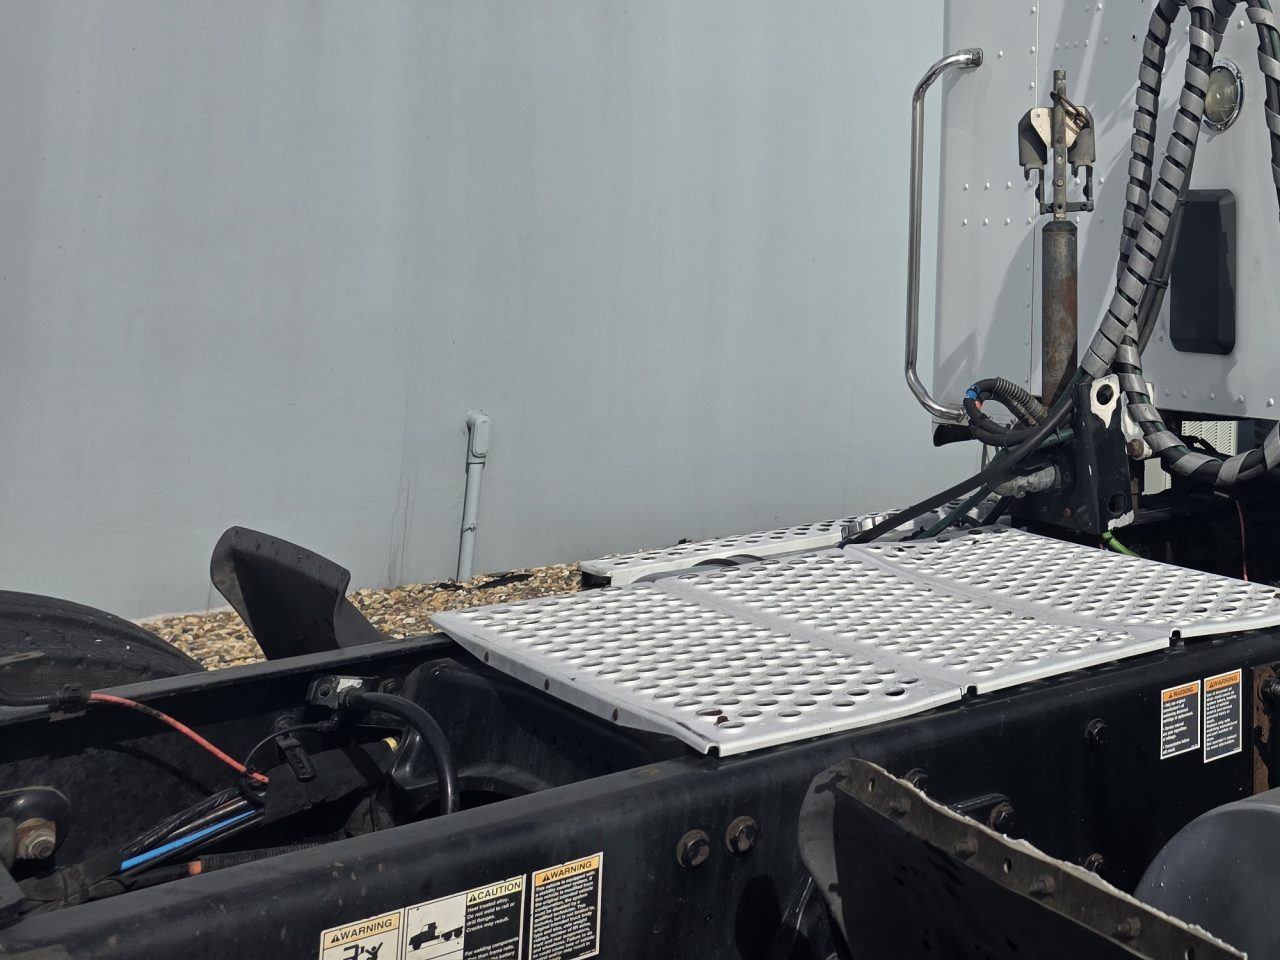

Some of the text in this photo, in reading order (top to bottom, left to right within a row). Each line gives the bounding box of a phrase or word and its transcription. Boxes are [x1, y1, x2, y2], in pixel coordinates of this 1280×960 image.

[1213, 675, 1238, 688] WARNING
[550, 861, 592, 879] WARNING
[477, 882, 521, 900] CAUTION
[340, 919, 392, 940] WARNING
